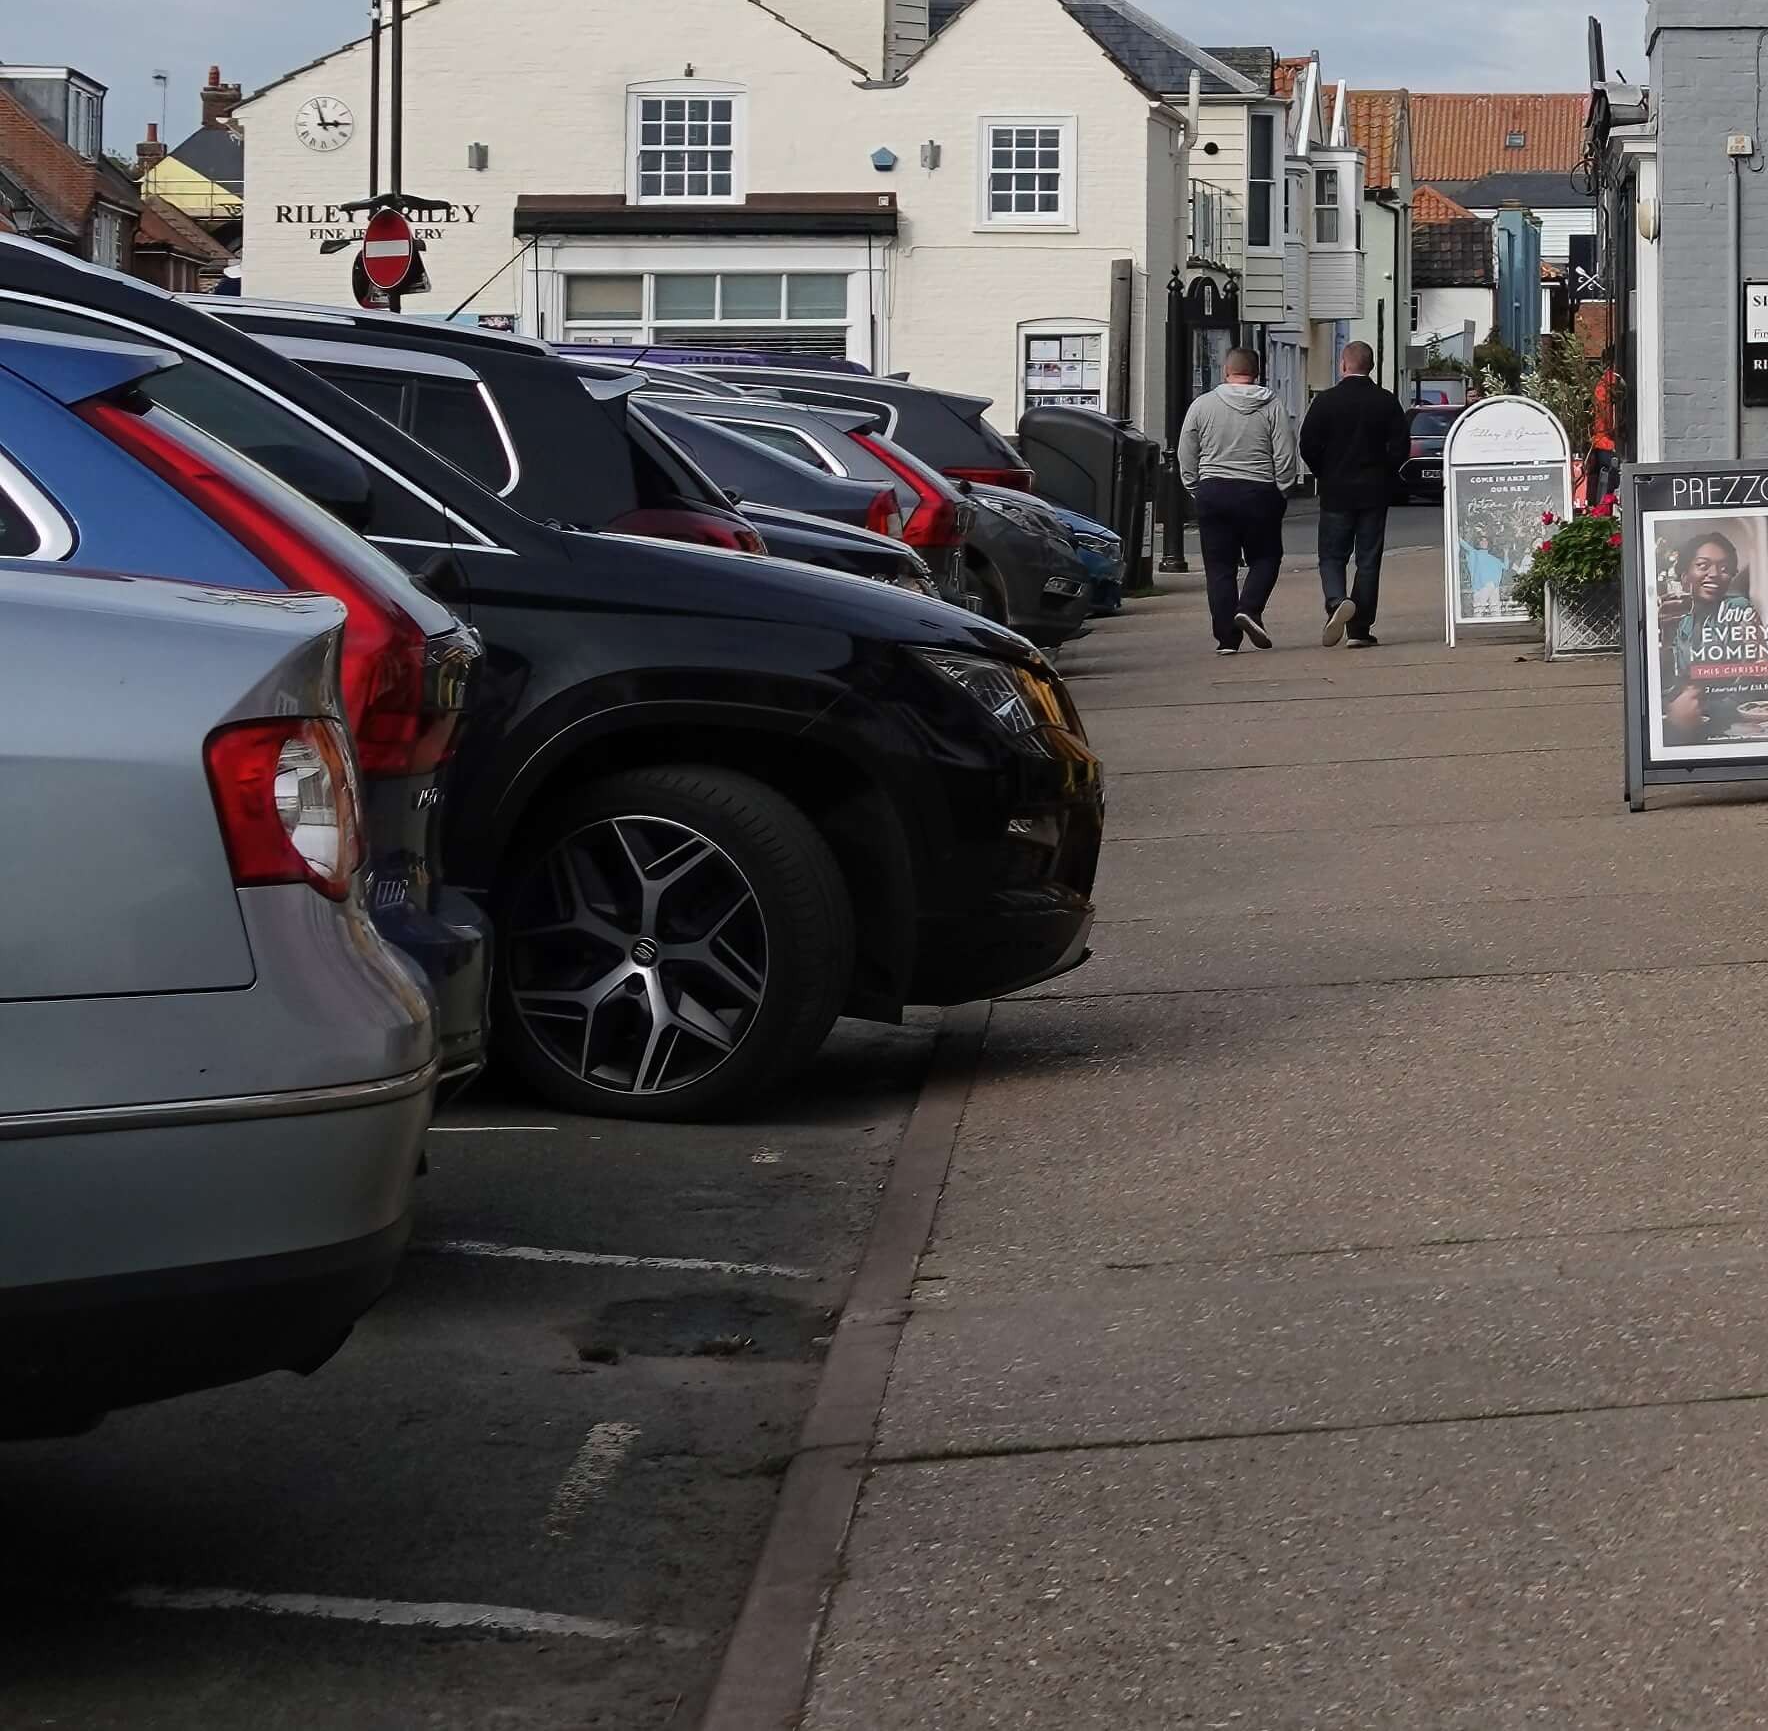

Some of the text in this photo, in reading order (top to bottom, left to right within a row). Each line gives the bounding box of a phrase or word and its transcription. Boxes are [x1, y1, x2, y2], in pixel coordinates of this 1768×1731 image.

[309, 228, 344, 240] FINE
[1470, 473, 1551, 484] COME IN AND SHOP
[1510, 485, 1531, 493] NEW
[1717, 600, 1757, 623] love
[1697, 667, 1720, 675] THIS
